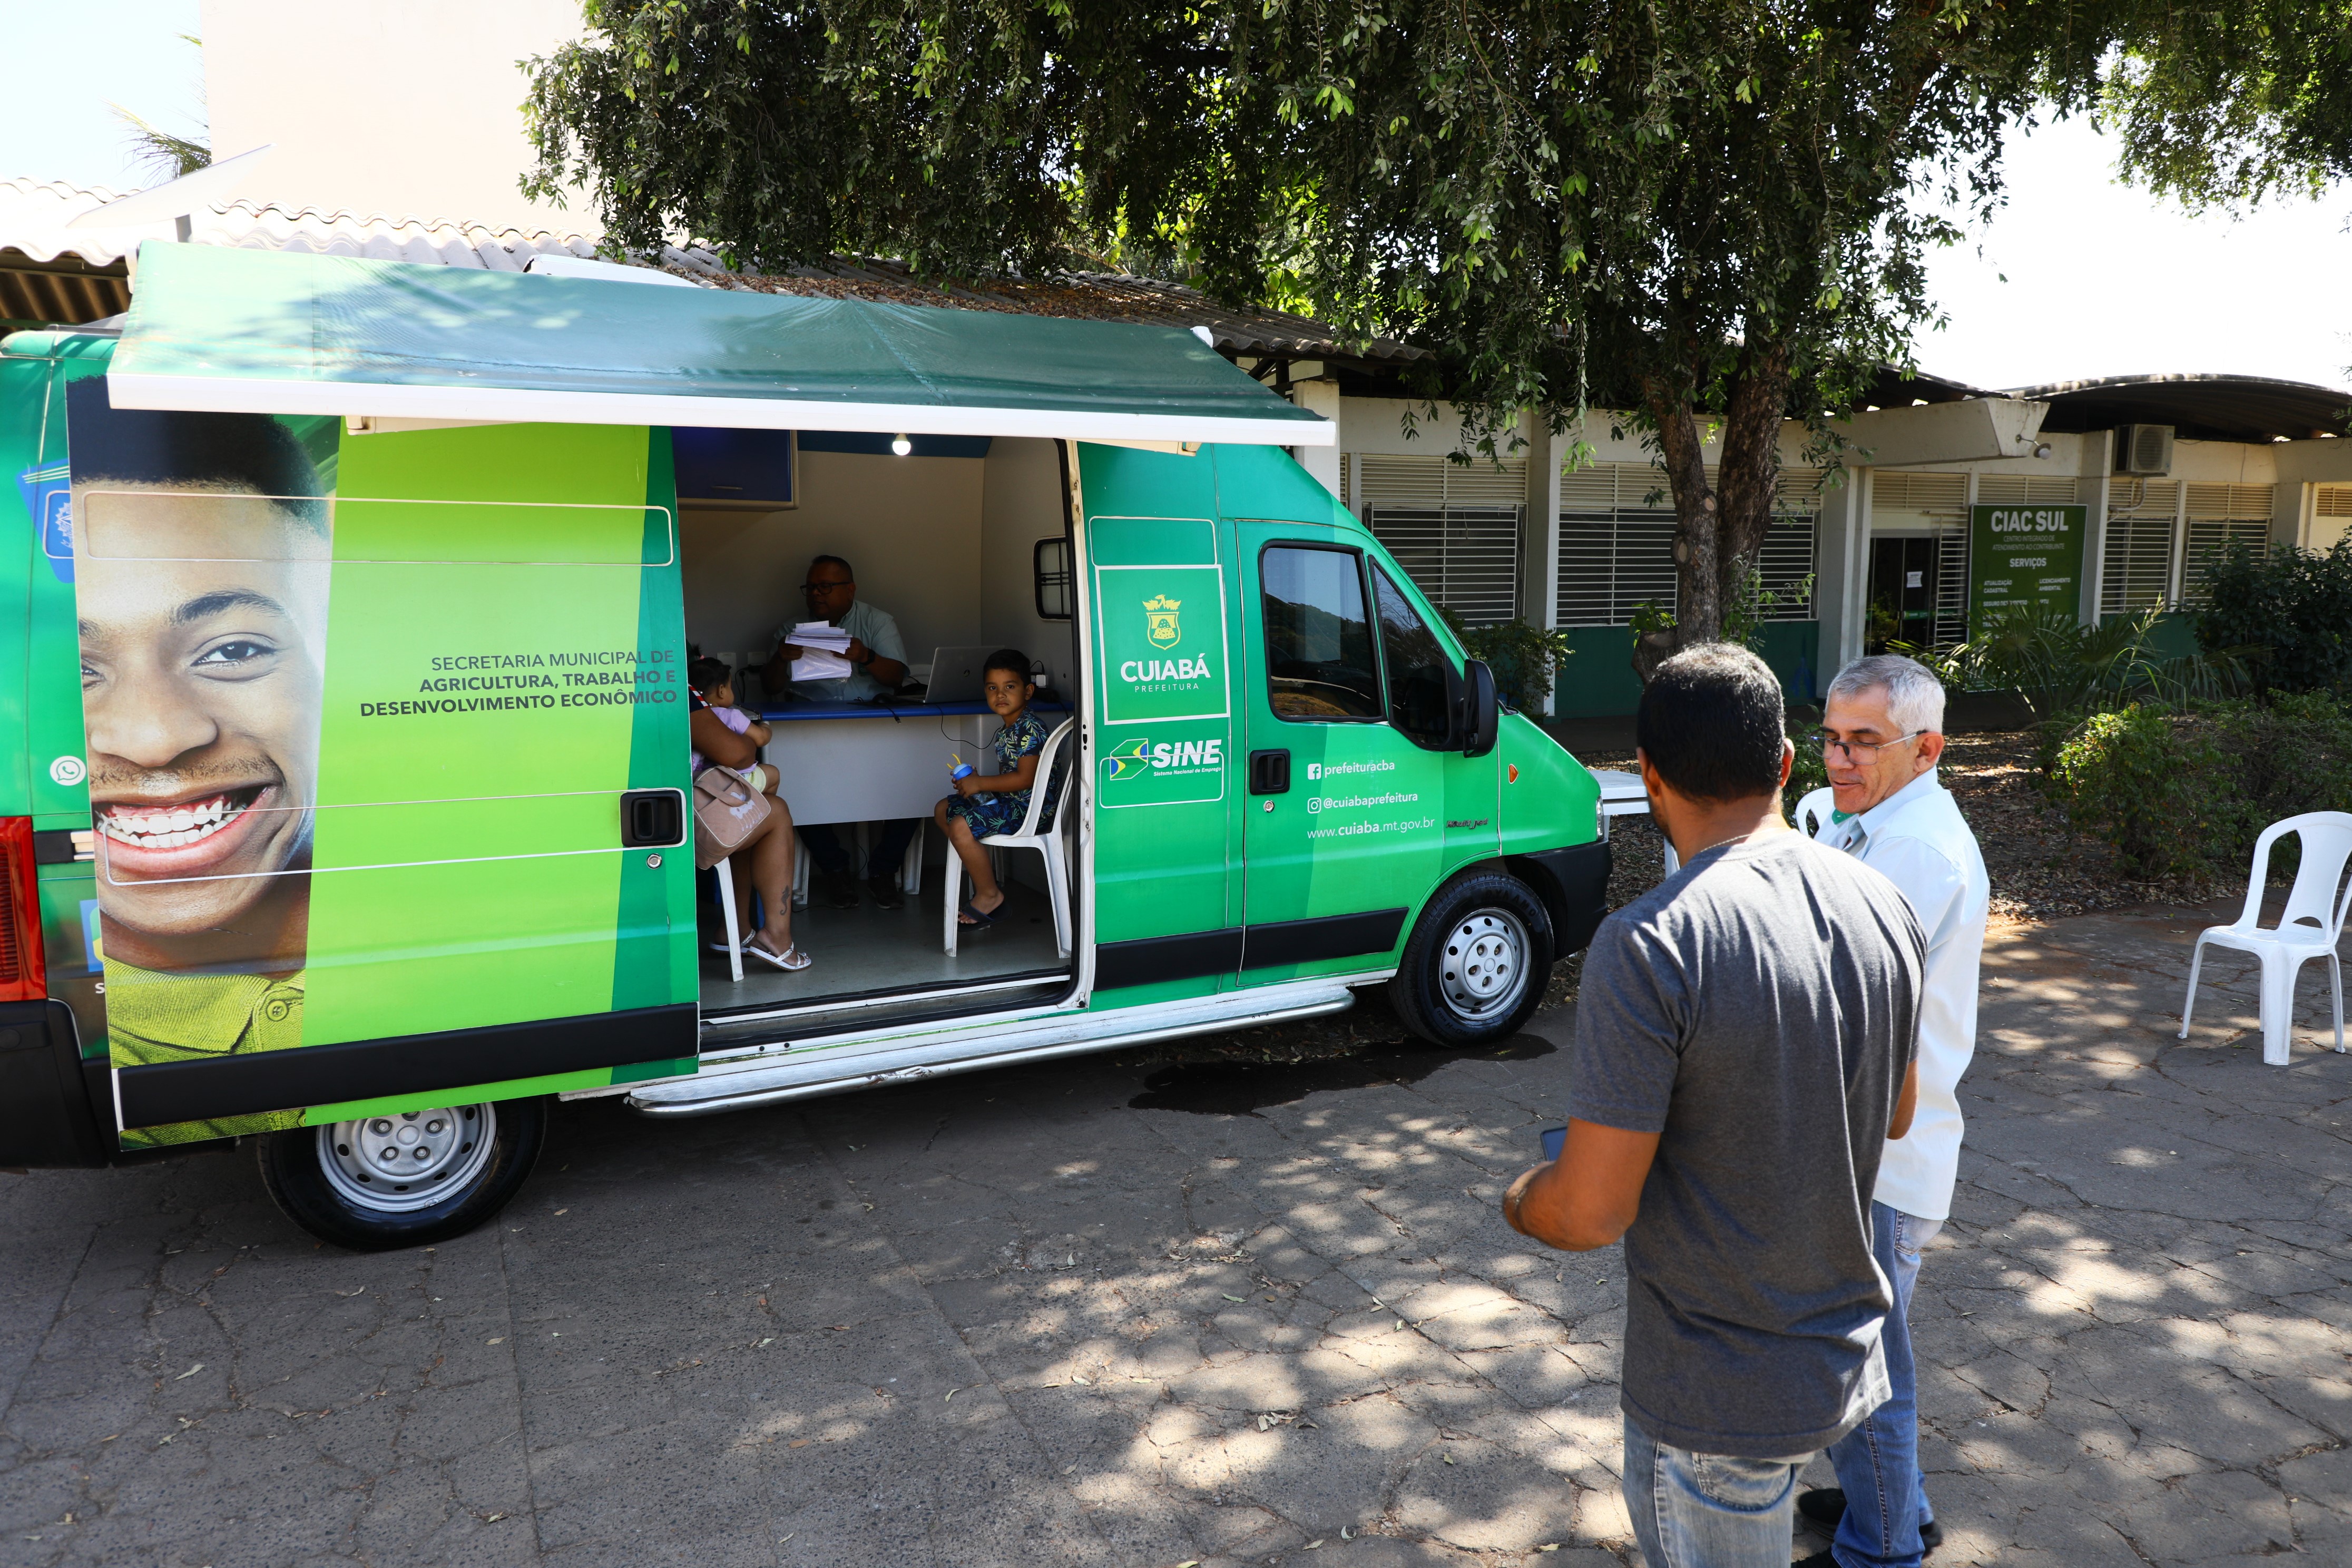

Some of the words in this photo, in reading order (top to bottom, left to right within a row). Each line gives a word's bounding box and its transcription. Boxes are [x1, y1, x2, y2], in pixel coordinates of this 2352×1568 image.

[1991, 511, 2033, 532] CIAC
[2035, 511, 2069, 532] SUL
[2010, 557, 2047, 569] SERVIÇOS
[432, 654, 544, 671] SECRETARIA
[549, 651, 646, 669] MUNICIPAL
[651, 650, 674, 663] DE
[1121, 653, 1211, 682] CUIABÁ
[419, 674, 558, 692] AGRICULTURA,
[563, 671, 661, 686] TRABALHO
[667, 670, 676, 682] E
[1135, 683, 1199, 693] PREFEITURA
[360, 694, 555, 716] DESENVOLVIMENTO
[561, 689, 677, 707] ECONÔMICO
[1325, 760, 1395, 778] prefeituracba
[1324, 792, 1418, 809] @cuiabaprefeitura
[1307, 816, 1435, 839] www.cuiaba.mt.gov.br
